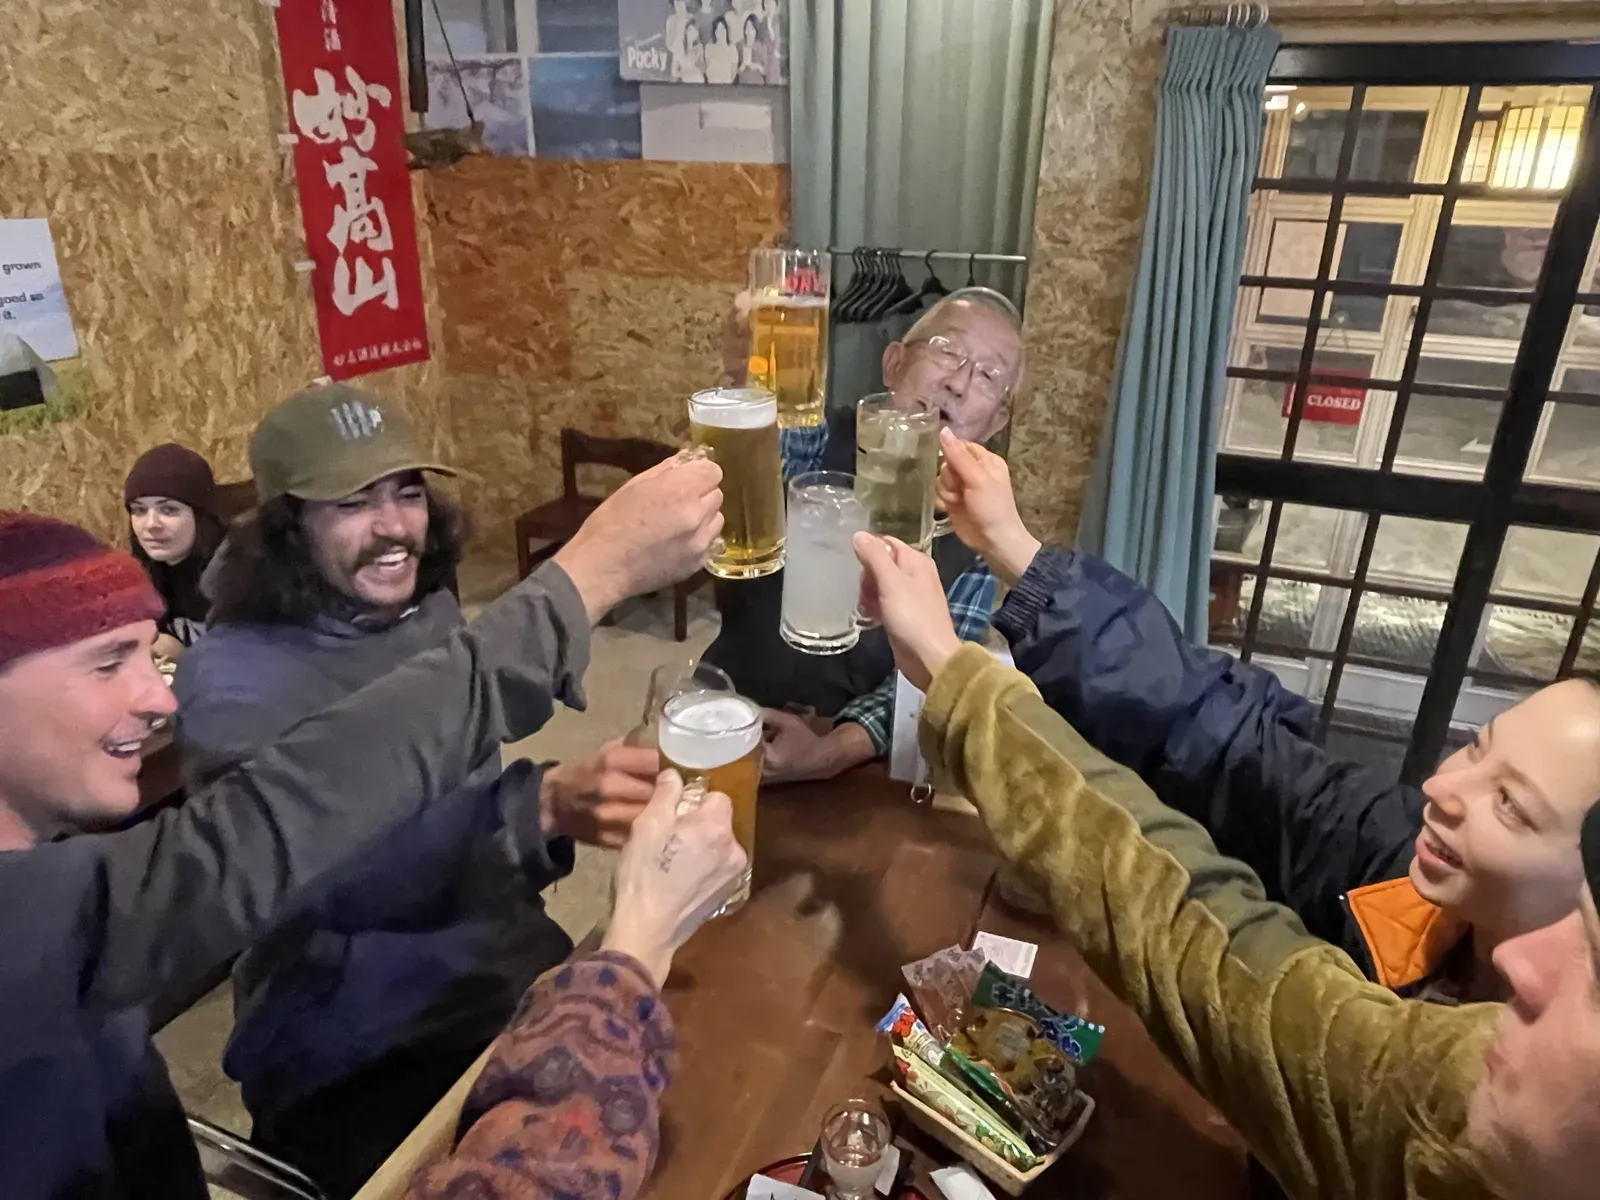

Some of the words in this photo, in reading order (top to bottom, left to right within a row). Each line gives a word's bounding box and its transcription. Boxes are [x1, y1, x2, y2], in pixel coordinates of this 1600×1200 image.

[627, 46, 668, 71] Pocky
[292, 65, 399, 316] 妙高山
[2, 261, 42, 275] grown
[1308, 395, 1361, 410] CLOSED
